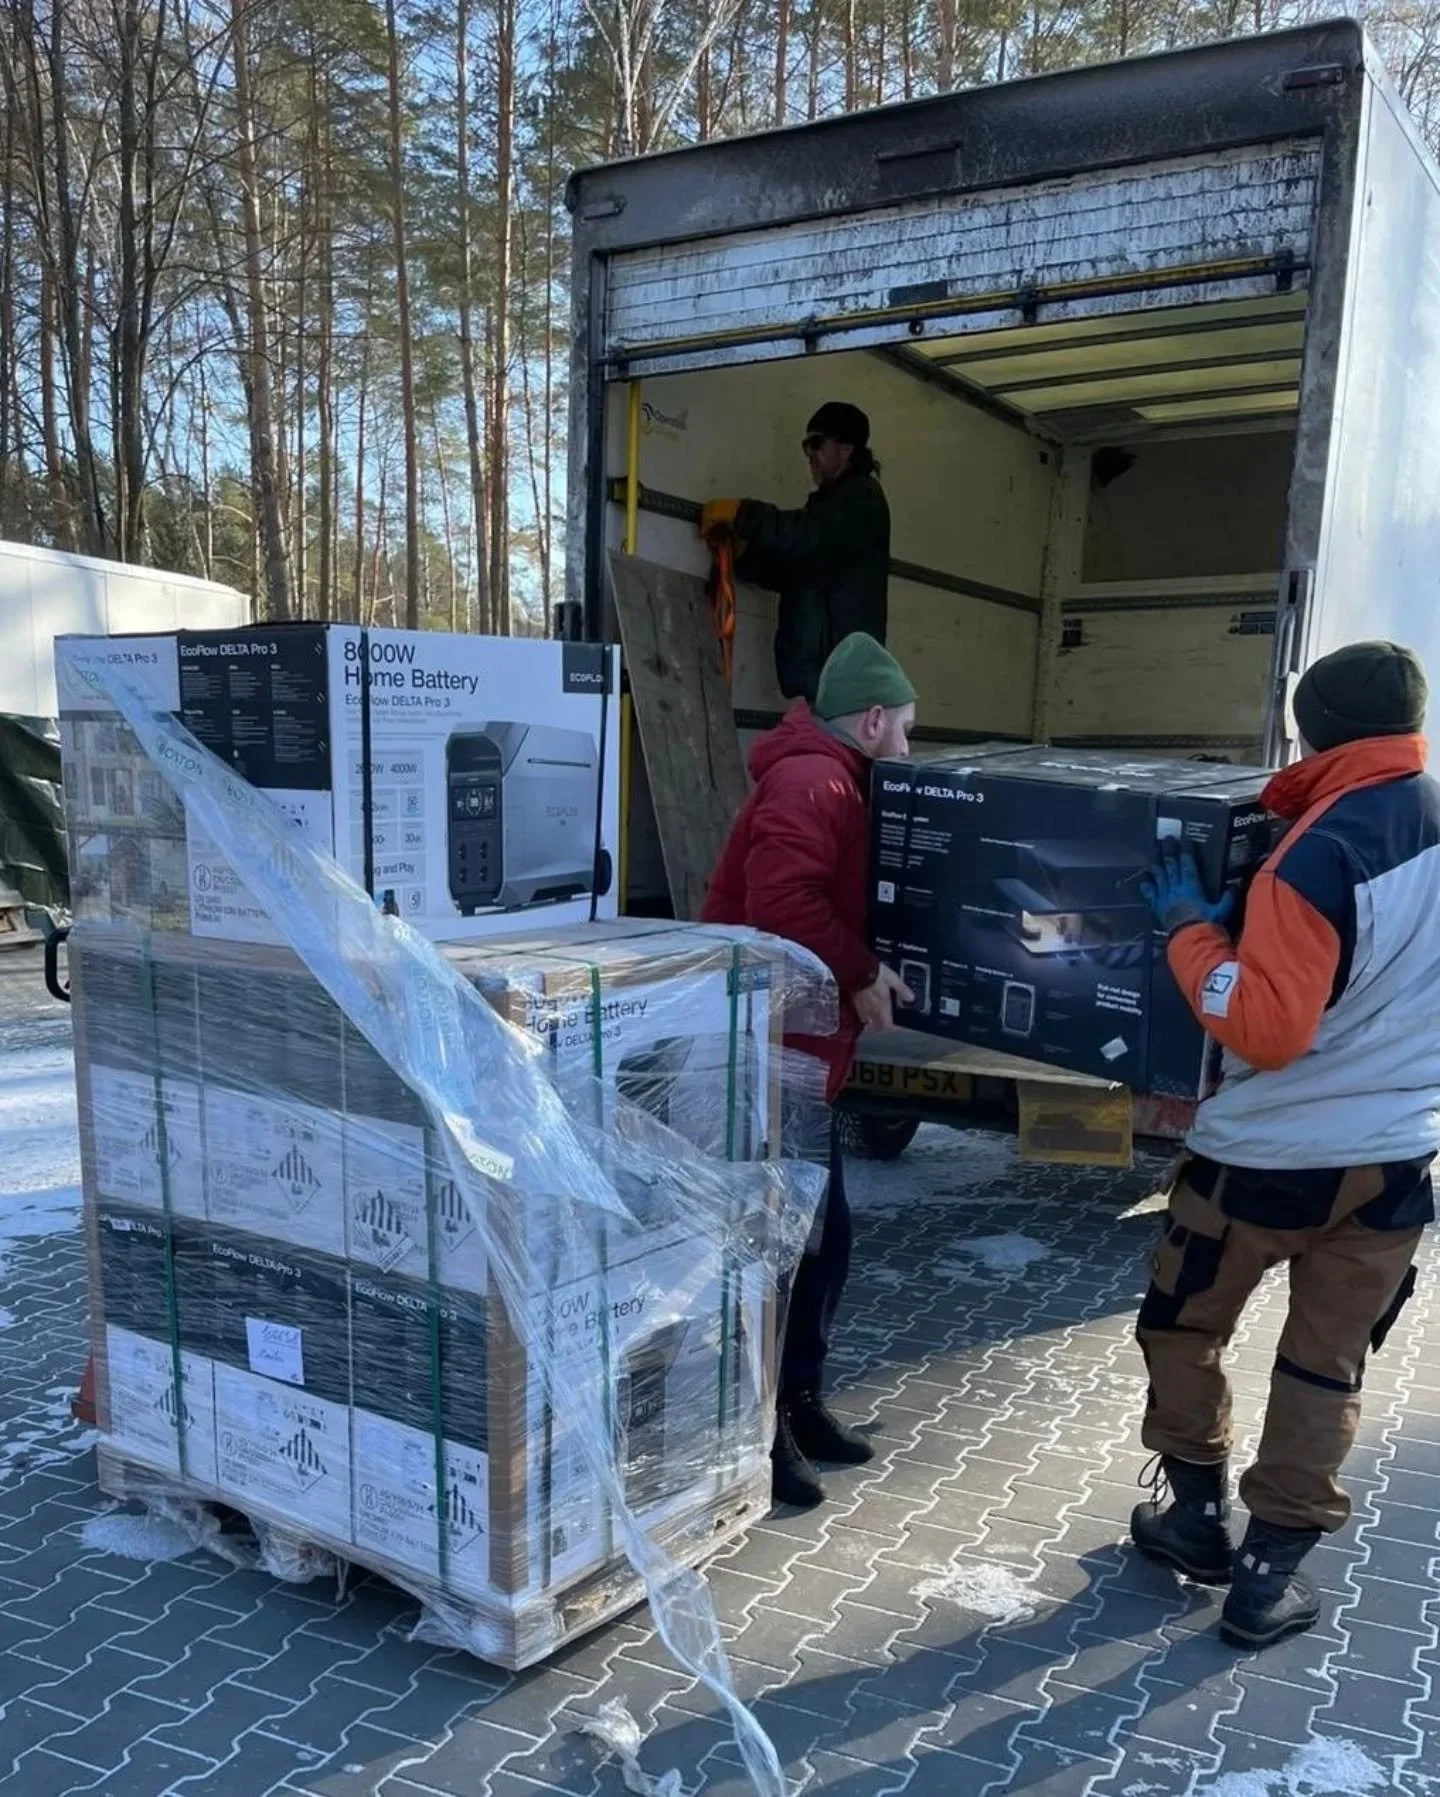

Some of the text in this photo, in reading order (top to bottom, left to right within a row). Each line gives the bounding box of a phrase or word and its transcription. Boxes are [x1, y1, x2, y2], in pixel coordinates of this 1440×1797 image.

[180, 643, 278, 657] EcoFlow DELTA Pro 3
[411, 668, 479, 695] Battery
[391, 695, 423, 707] DELTA
[424, 696, 442, 708] Pro
[444, 697, 452, 708] 3
[924, 785, 955, 799] DELTA
[955, 790, 975, 803] Pro
[976, 792, 985, 803] 3
